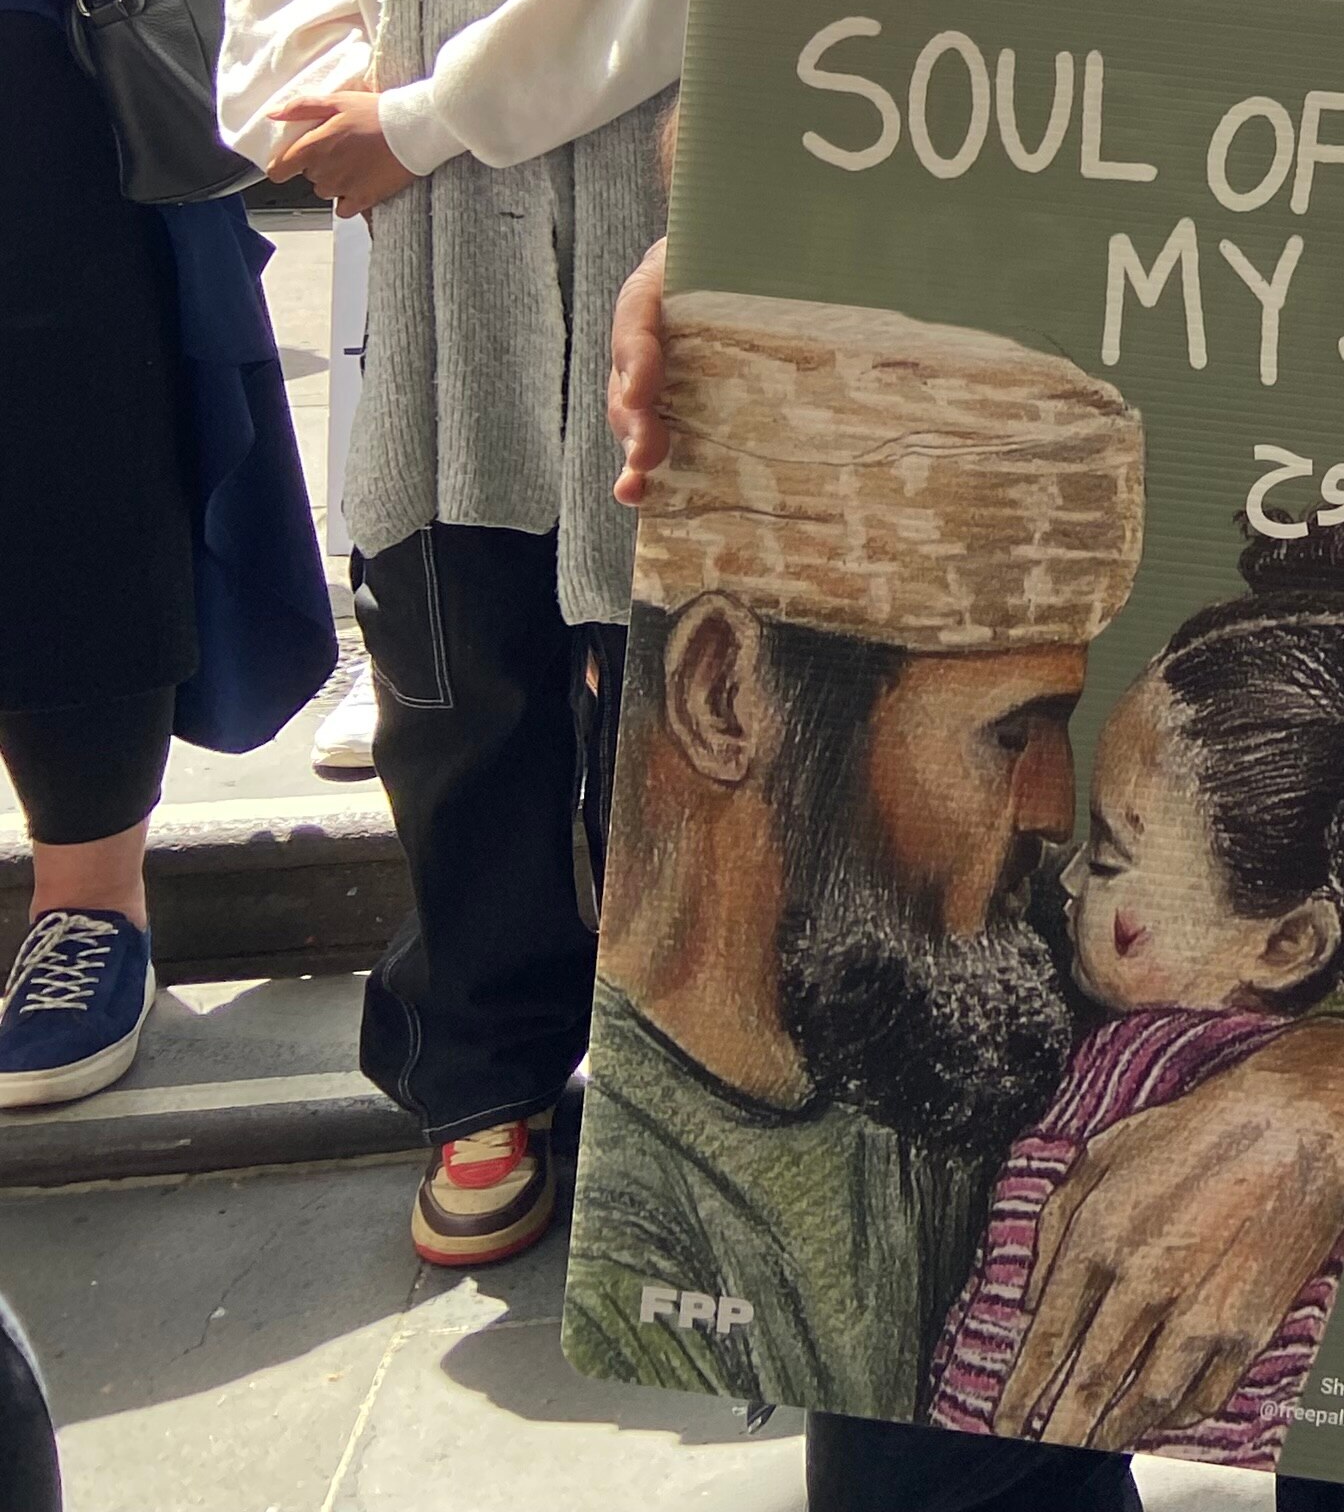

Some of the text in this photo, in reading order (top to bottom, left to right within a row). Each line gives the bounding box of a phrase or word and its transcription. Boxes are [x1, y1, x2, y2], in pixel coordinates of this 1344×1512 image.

[796, 15, 1157, 182] SOUL
[1100, 217, 1304, 386] MY
[637, 1285, 756, 1336] FPP
